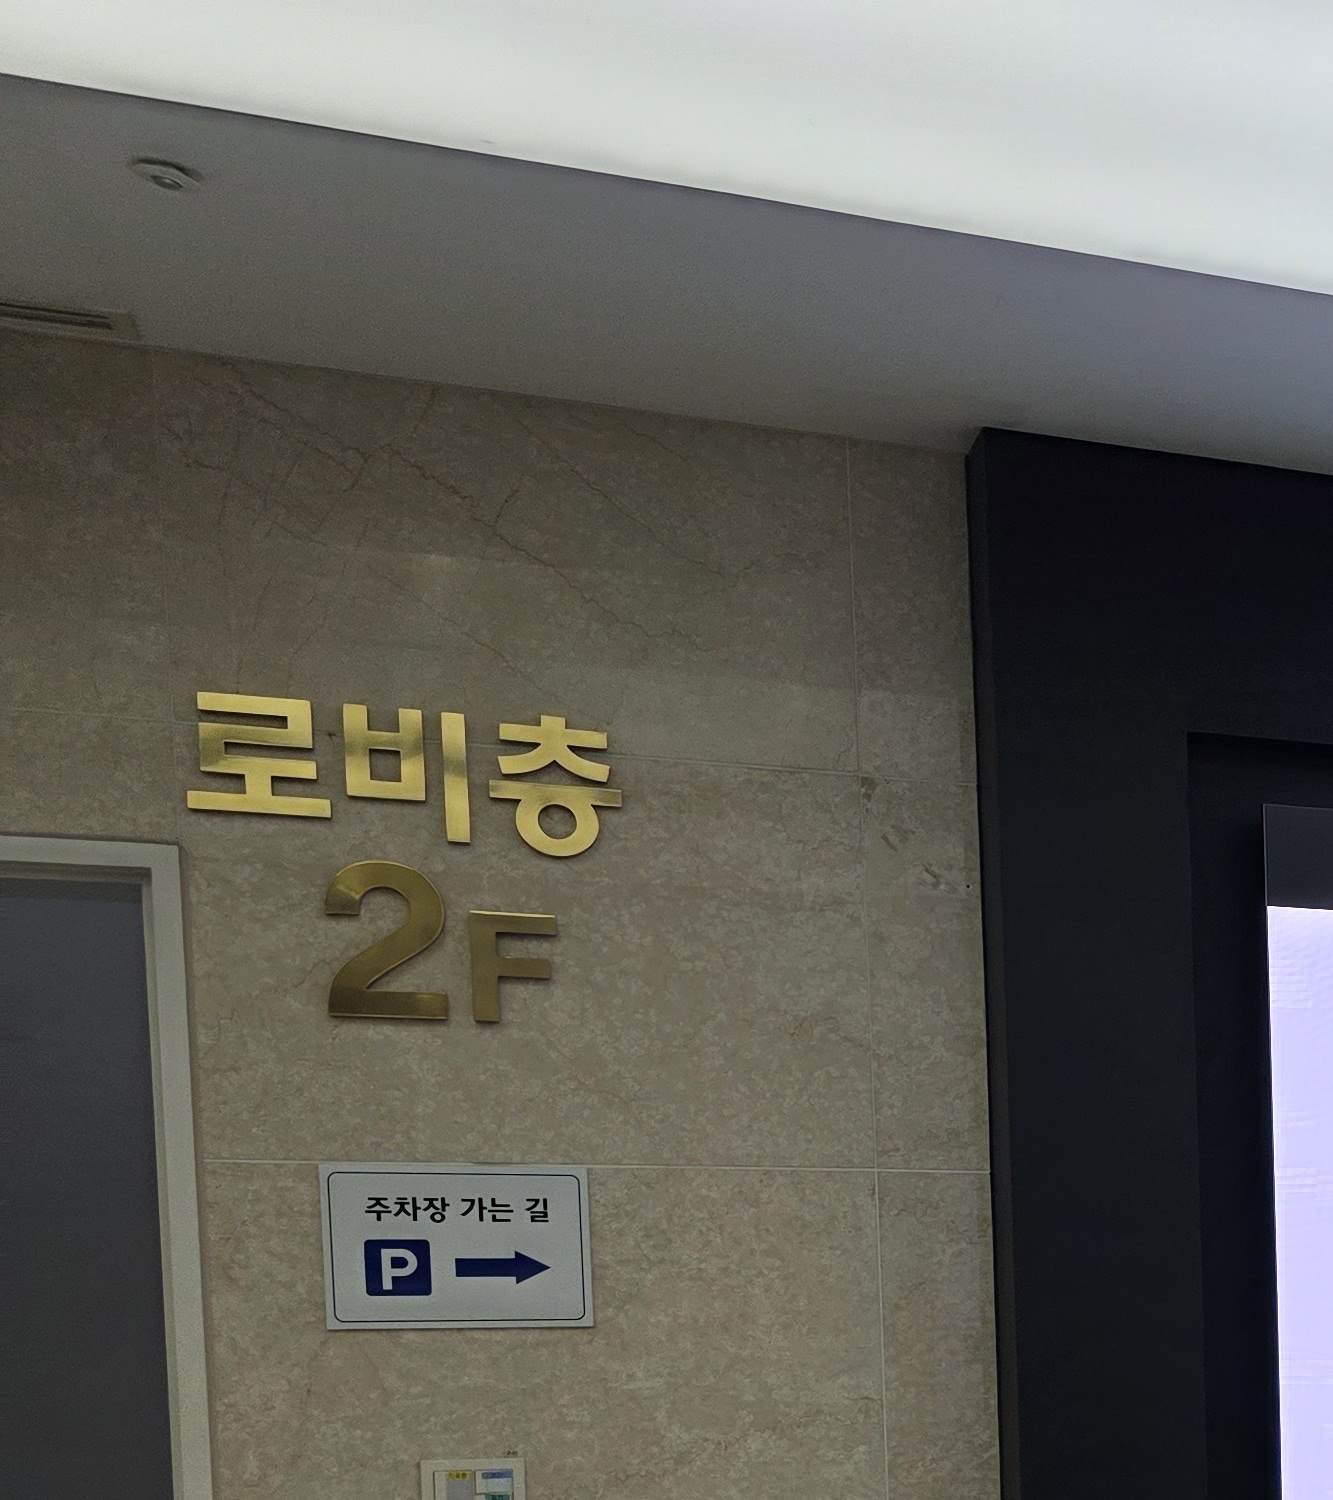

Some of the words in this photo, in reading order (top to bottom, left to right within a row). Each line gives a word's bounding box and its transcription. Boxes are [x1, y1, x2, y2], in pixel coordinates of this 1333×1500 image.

[187, 691, 623, 857] 로비층
[324, 860, 558, 1024] 2F
[364, 1196, 450, 1224] 주차장
[460, 1197, 515, 1224] 가는
[525, 1197, 550, 1224] 길
[380, 1248, 418, 1290] P
